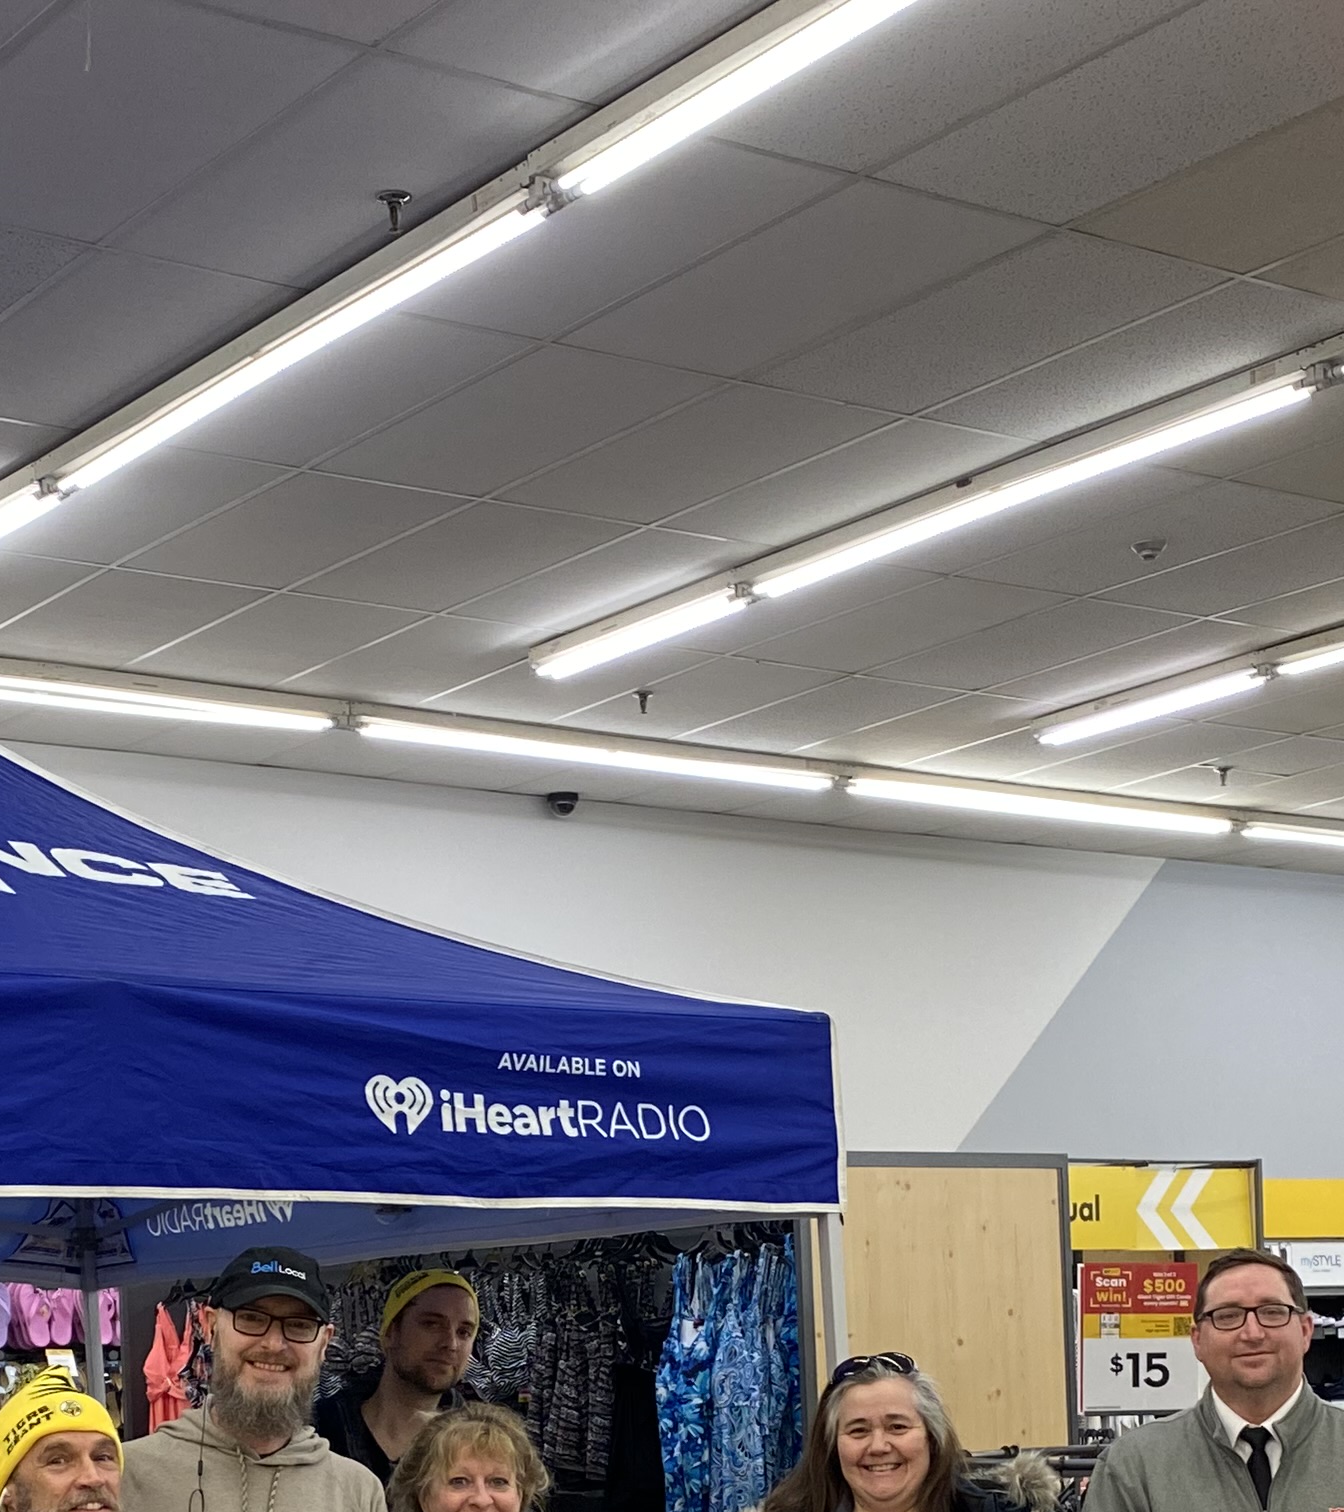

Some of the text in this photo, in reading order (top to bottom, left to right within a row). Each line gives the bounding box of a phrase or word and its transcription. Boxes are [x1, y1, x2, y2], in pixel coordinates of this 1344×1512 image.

[497, 1052, 641, 1078] AVAILABLE ON
[439, 1088, 711, 1142] iHeartRADIO
[251, 1261, 278, 1275] Bell
[1095, 1277, 1127, 1287] Scan
[1143, 1279, 1186, 1293] $500
[1096, 1287, 1127, 1303] Win!
[1110, 1352, 1170, 1387] $15
